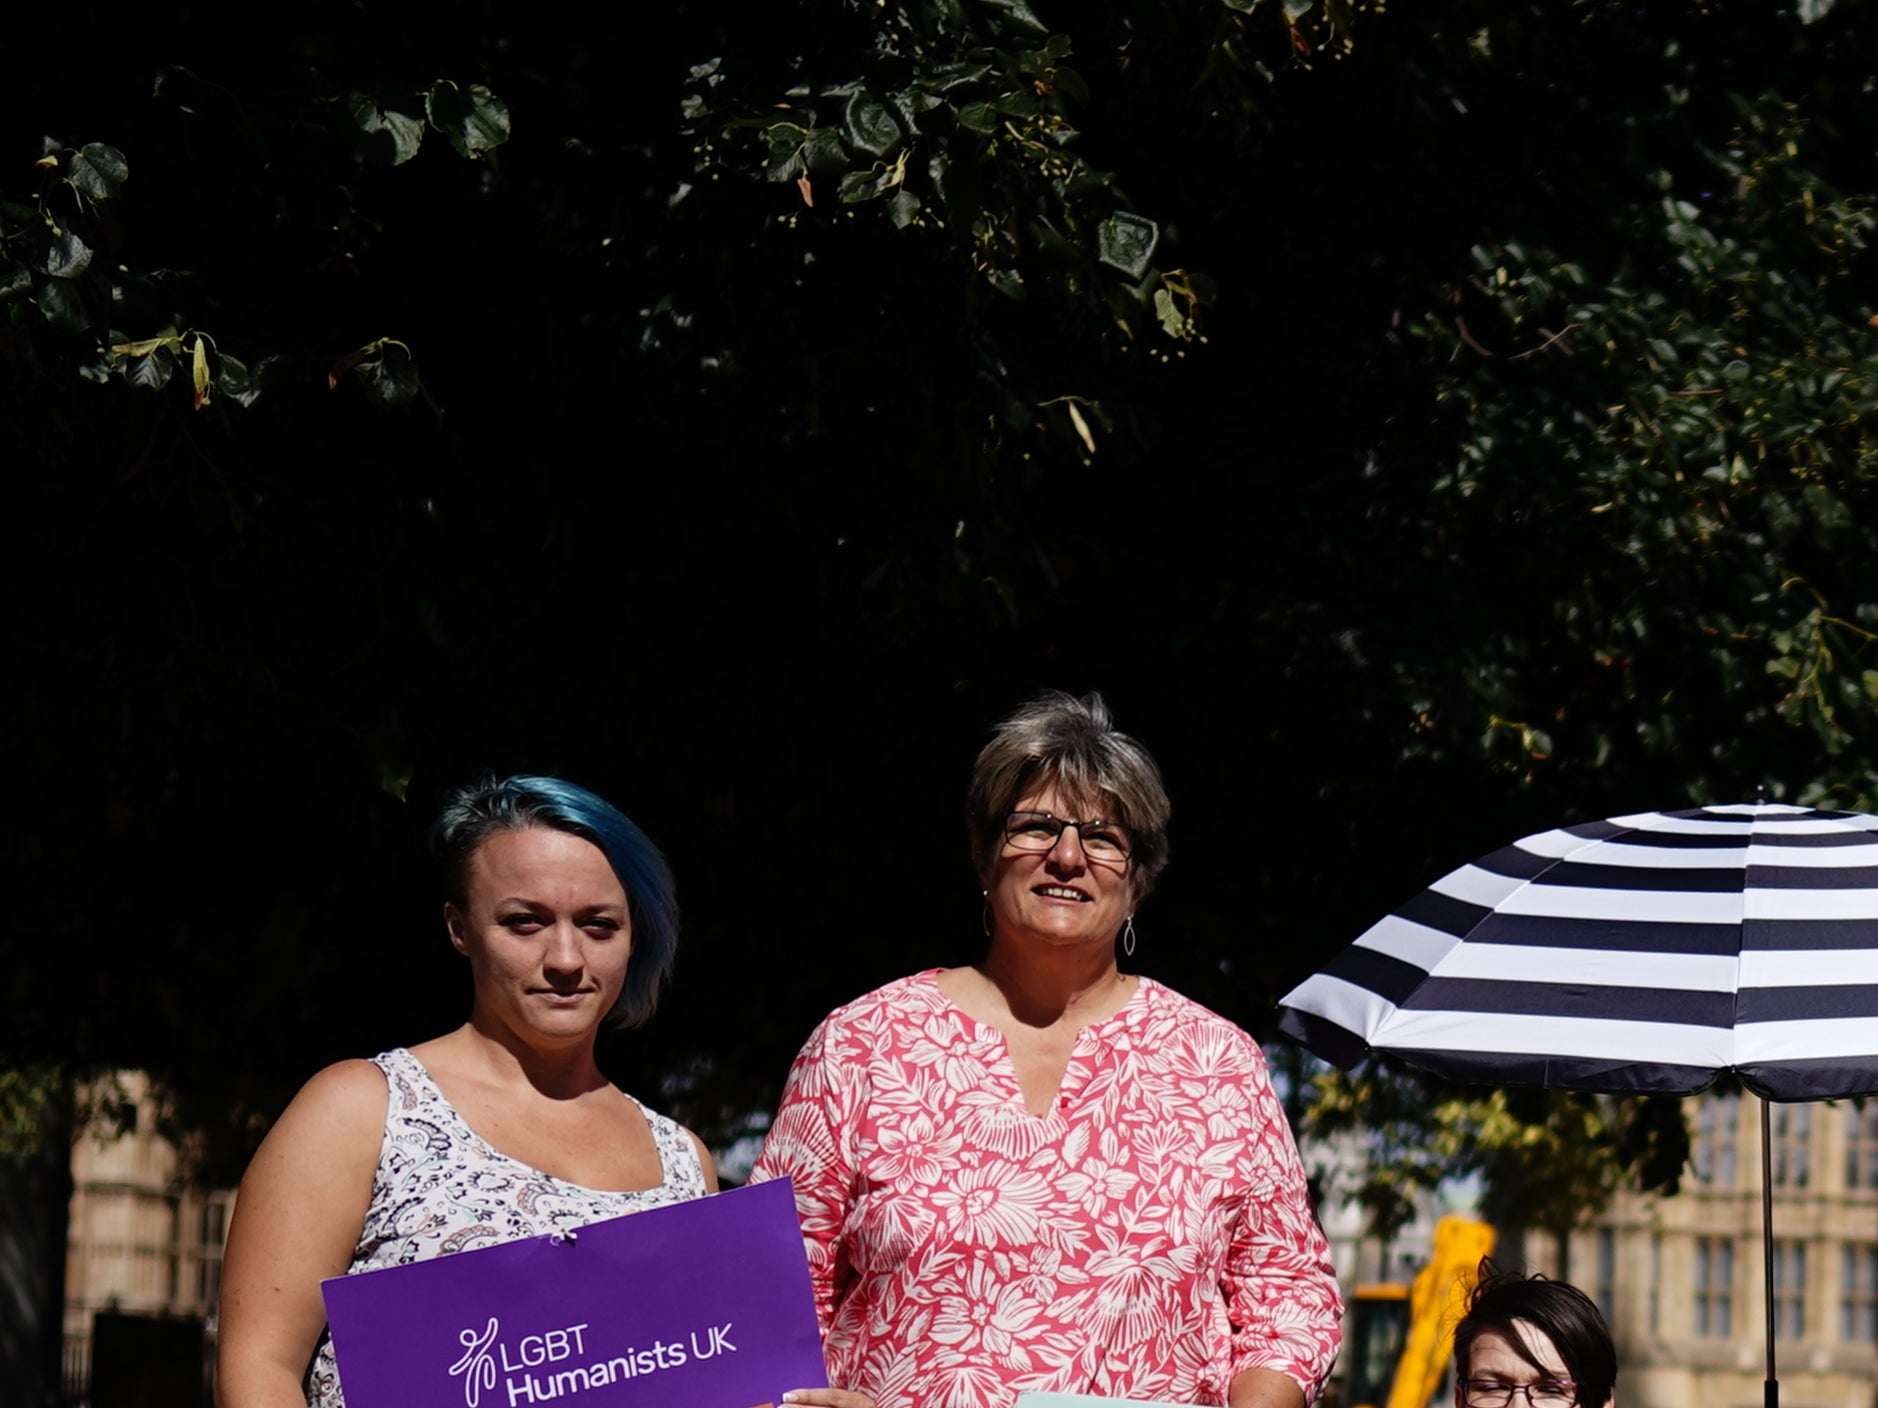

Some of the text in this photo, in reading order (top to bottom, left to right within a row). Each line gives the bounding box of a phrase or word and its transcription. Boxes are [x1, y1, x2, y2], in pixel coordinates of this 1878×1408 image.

[501, 1324, 588, 1372] LGBT
[506, 1323, 736, 1408] Humanists UK
